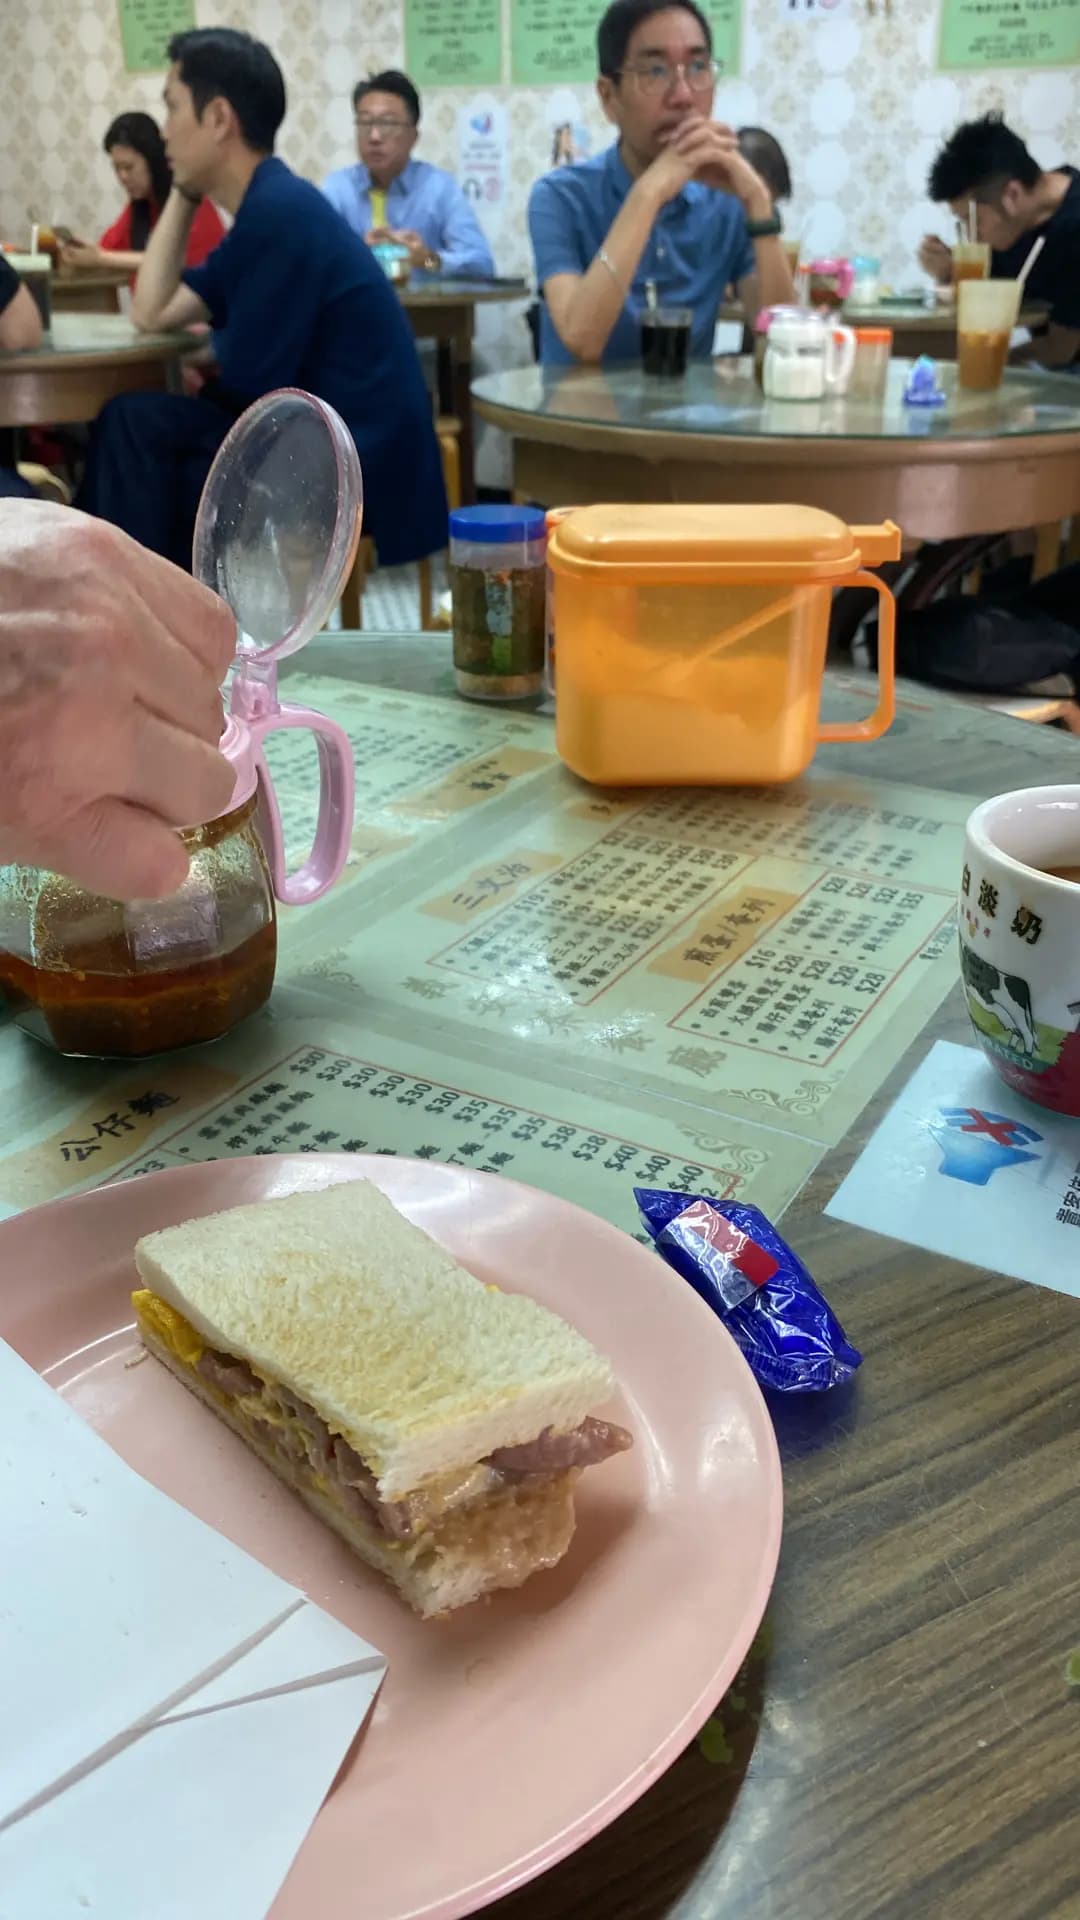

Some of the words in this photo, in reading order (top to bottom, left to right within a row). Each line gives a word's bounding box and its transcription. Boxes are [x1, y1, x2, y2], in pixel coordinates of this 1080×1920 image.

[452, 863, 531, 910] 三文治
[870, 887, 899, 904] $32
[744, 949, 776, 968] $16
[772, 954, 804, 975] $28
[799, 960, 832, 980] $28
[827, 965, 859, 987] $28
[854, 972, 886, 994] $28
[290, 1050, 326, 1075] $30
[316, 1059, 352, 1082] $30
[342, 1068, 378, 1090] $30
[369, 1075, 405, 1098] $30
[396, 1083, 432, 1106] $30
[424, 1092, 460, 1114] $30
[452, 1099, 488, 1123] $35
[481, 1107, 517, 1134] $35
[60, 1090, 180, 1162] 公仔麵
[511, 1117, 547, 1141] $35
[541, 1126, 576, 1151] $38
[572, 1135, 608, 1161] $38
[602, 1144, 640, 1172] $40
[635, 1155, 671, 1182] $40
[668, 1166, 704, 1192] $40
